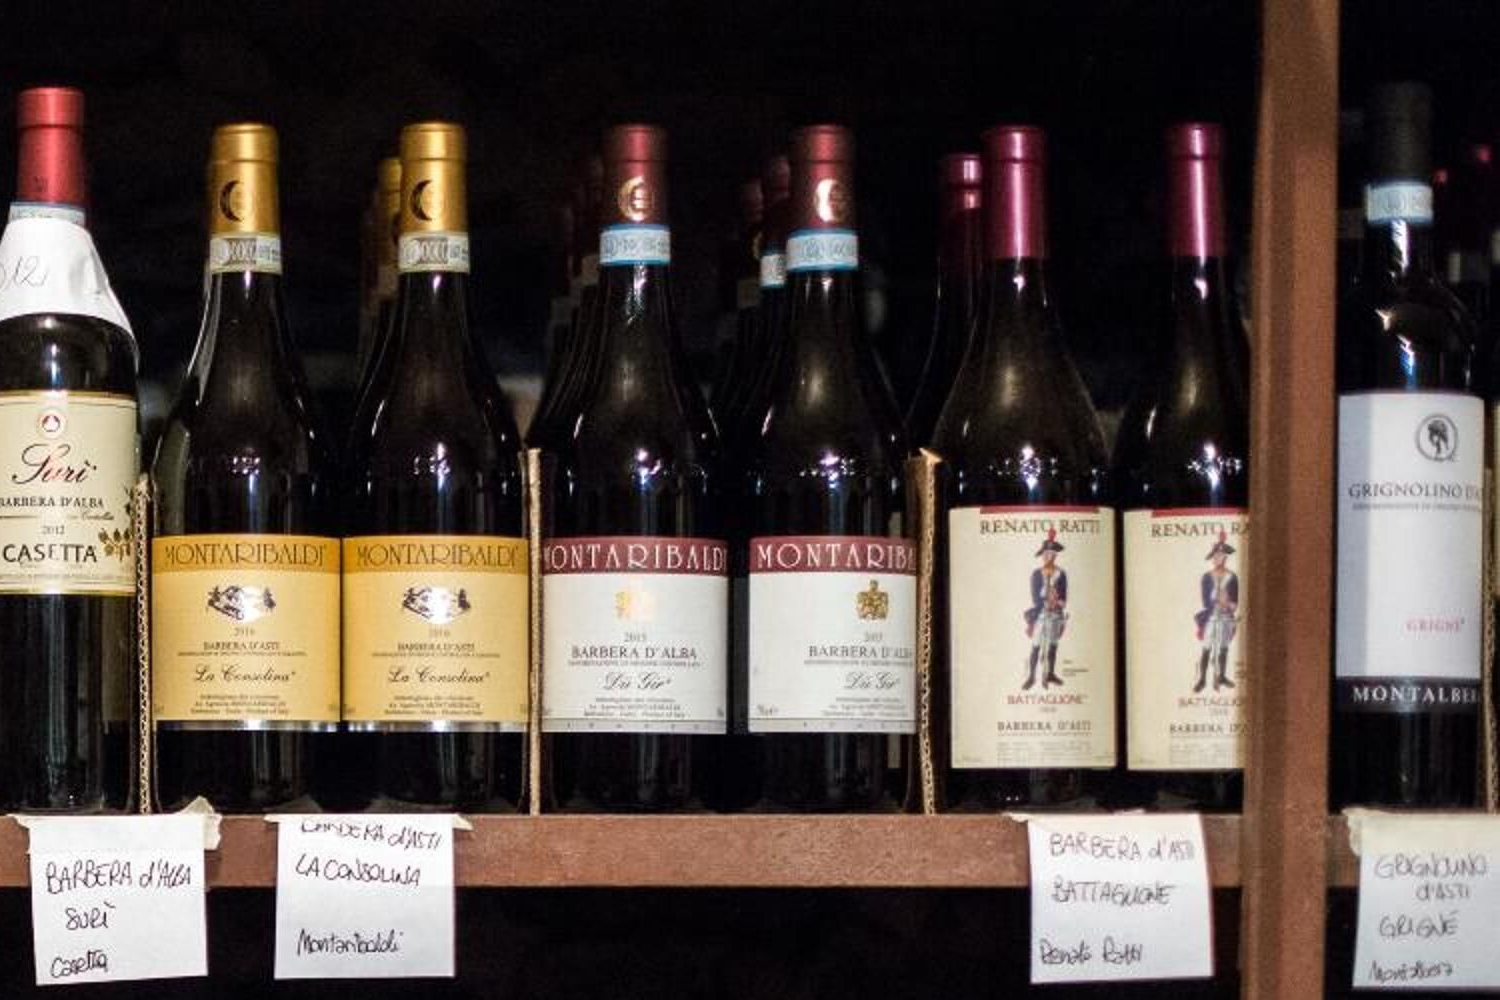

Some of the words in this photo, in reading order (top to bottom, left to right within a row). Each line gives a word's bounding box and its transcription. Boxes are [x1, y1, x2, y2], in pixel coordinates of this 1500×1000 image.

[1348, 482, 1463, 499] GRIGNOLINO
[979, 518, 1052, 536] RENATO
[2, 543, 98, 563] CASETTA
[164, 542, 326, 567] MONTARIBALDI
[571, 645, 640, 659] BARBERA
[808, 645, 878, 658] BARBERA
[1049, 831, 1143, 861] BARBERA
[295, 853, 321, 878] LA
[46, 858, 133, 896] BARBERA
[139, 858, 192, 890] d'ALBA
